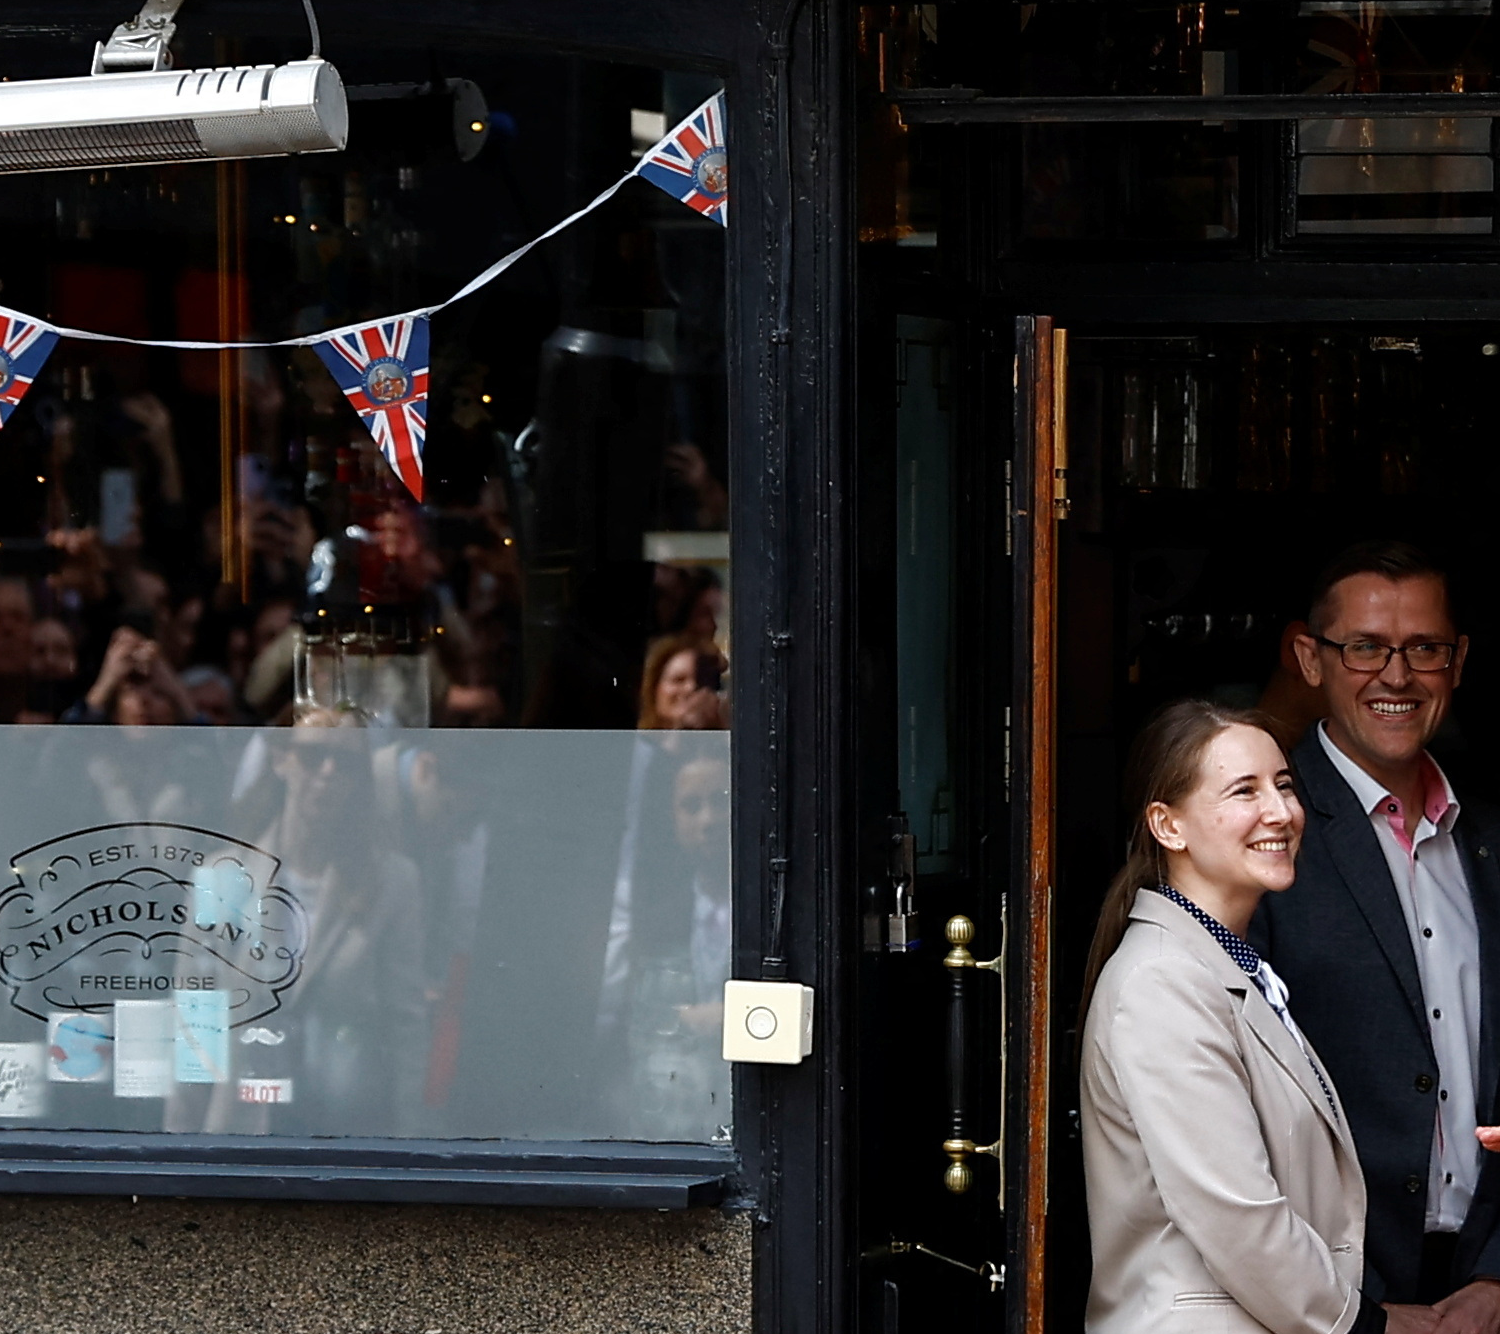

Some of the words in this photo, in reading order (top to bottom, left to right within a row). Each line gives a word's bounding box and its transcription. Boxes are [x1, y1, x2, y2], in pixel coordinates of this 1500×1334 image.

[88, 843, 139, 867] EST.
[151, 845, 206, 867] 1873
[79, 974, 216, 991] FREEHOUSE
